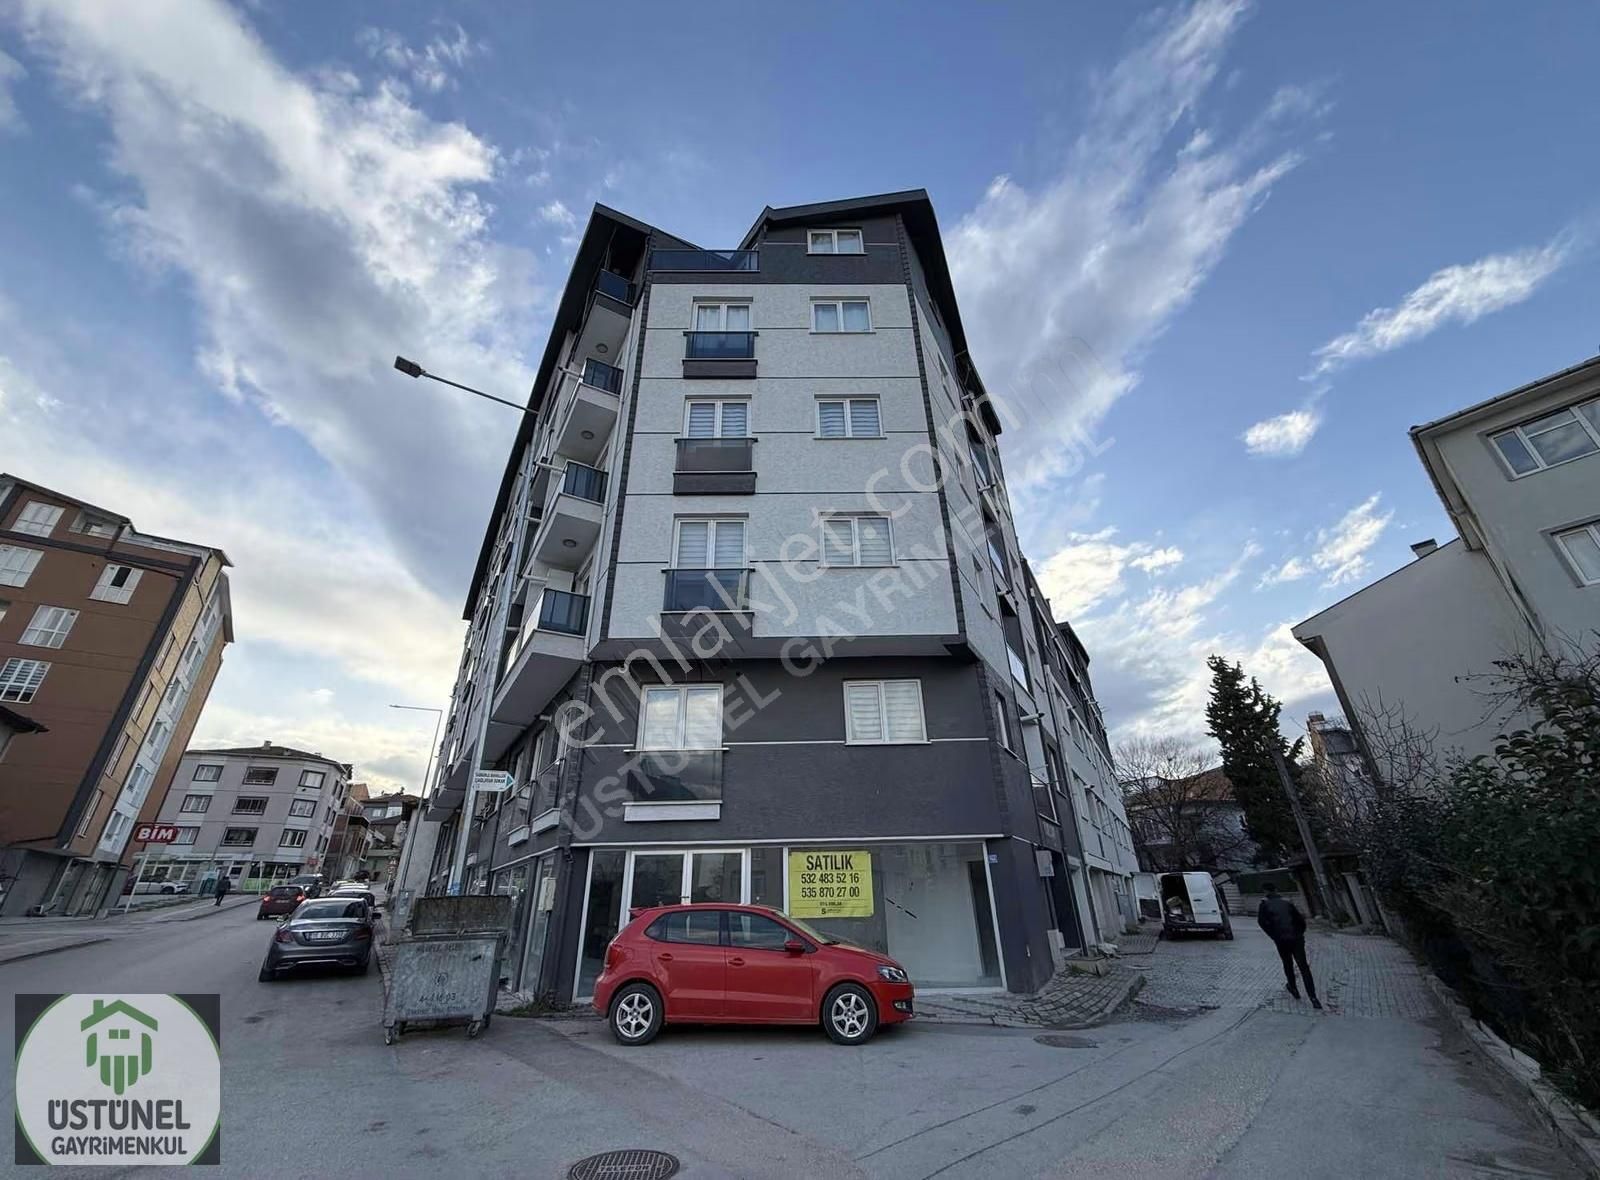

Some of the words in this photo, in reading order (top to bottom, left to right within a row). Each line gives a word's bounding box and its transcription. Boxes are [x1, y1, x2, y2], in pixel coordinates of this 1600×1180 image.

[137, 825, 174, 840] BİM
[806, 854, 853, 871] SATILIK
[801, 873, 816, 884] 532
[819, 873, 834, 883] 483
[836, 873, 846, 883] 52
[849, 872, 859, 883] 16
[801, 887, 817, 898] 535
[819, 887, 834, 898] 870
[837, 887, 847, 897] 27
[849, 886, 860, 897] 00
